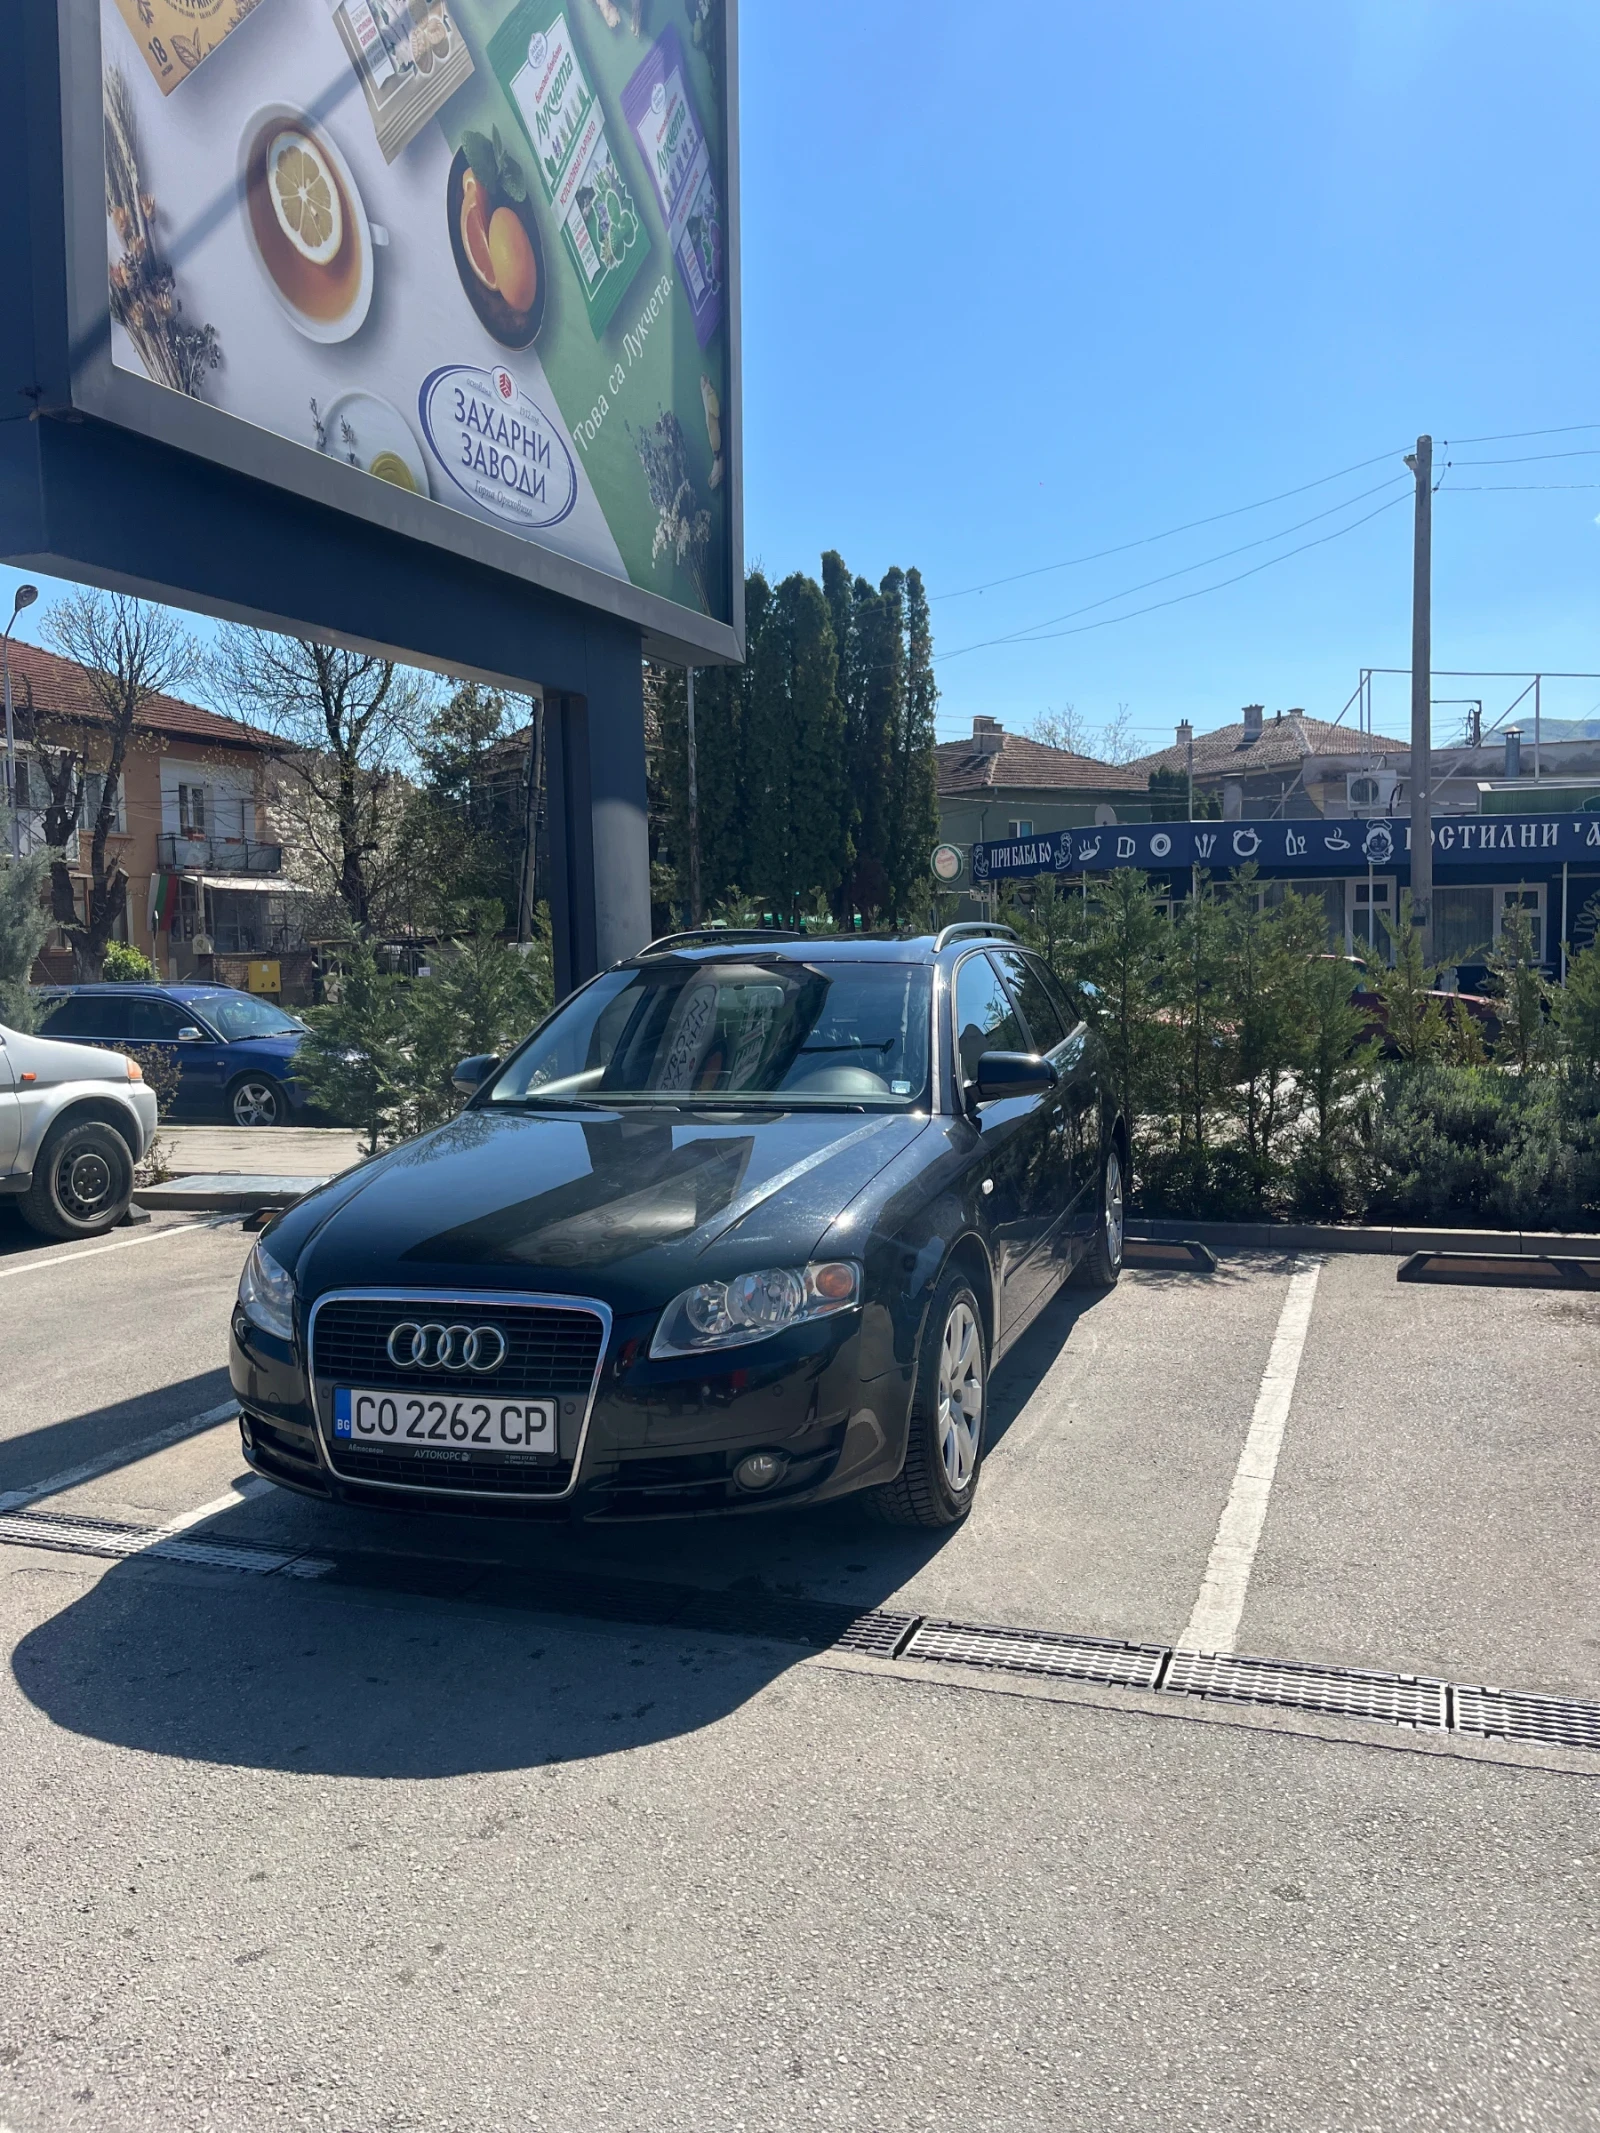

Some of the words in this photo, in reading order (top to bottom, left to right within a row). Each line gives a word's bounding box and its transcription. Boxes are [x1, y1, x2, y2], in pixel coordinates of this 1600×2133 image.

[148, 36, 169, 67] 18
[535, 52, 573, 146] Лукчета
[572, 394, 610, 451] Това
[608, 363, 626, 395] са
[622, 275, 674, 367] Лукчета.
[454, 387, 551, 470] ЗАХАРНИ
[461, 432, 547, 504] ЗАВОДИ
[991, 848, 1011, 869] ПРИ
[1012, 843, 1038, 866] БАБА
[337, 1419, 350, 1431] BG
[406, 1400, 491, 1443] 2262
[413, 1449, 461, 1460] АУТОКОРС
